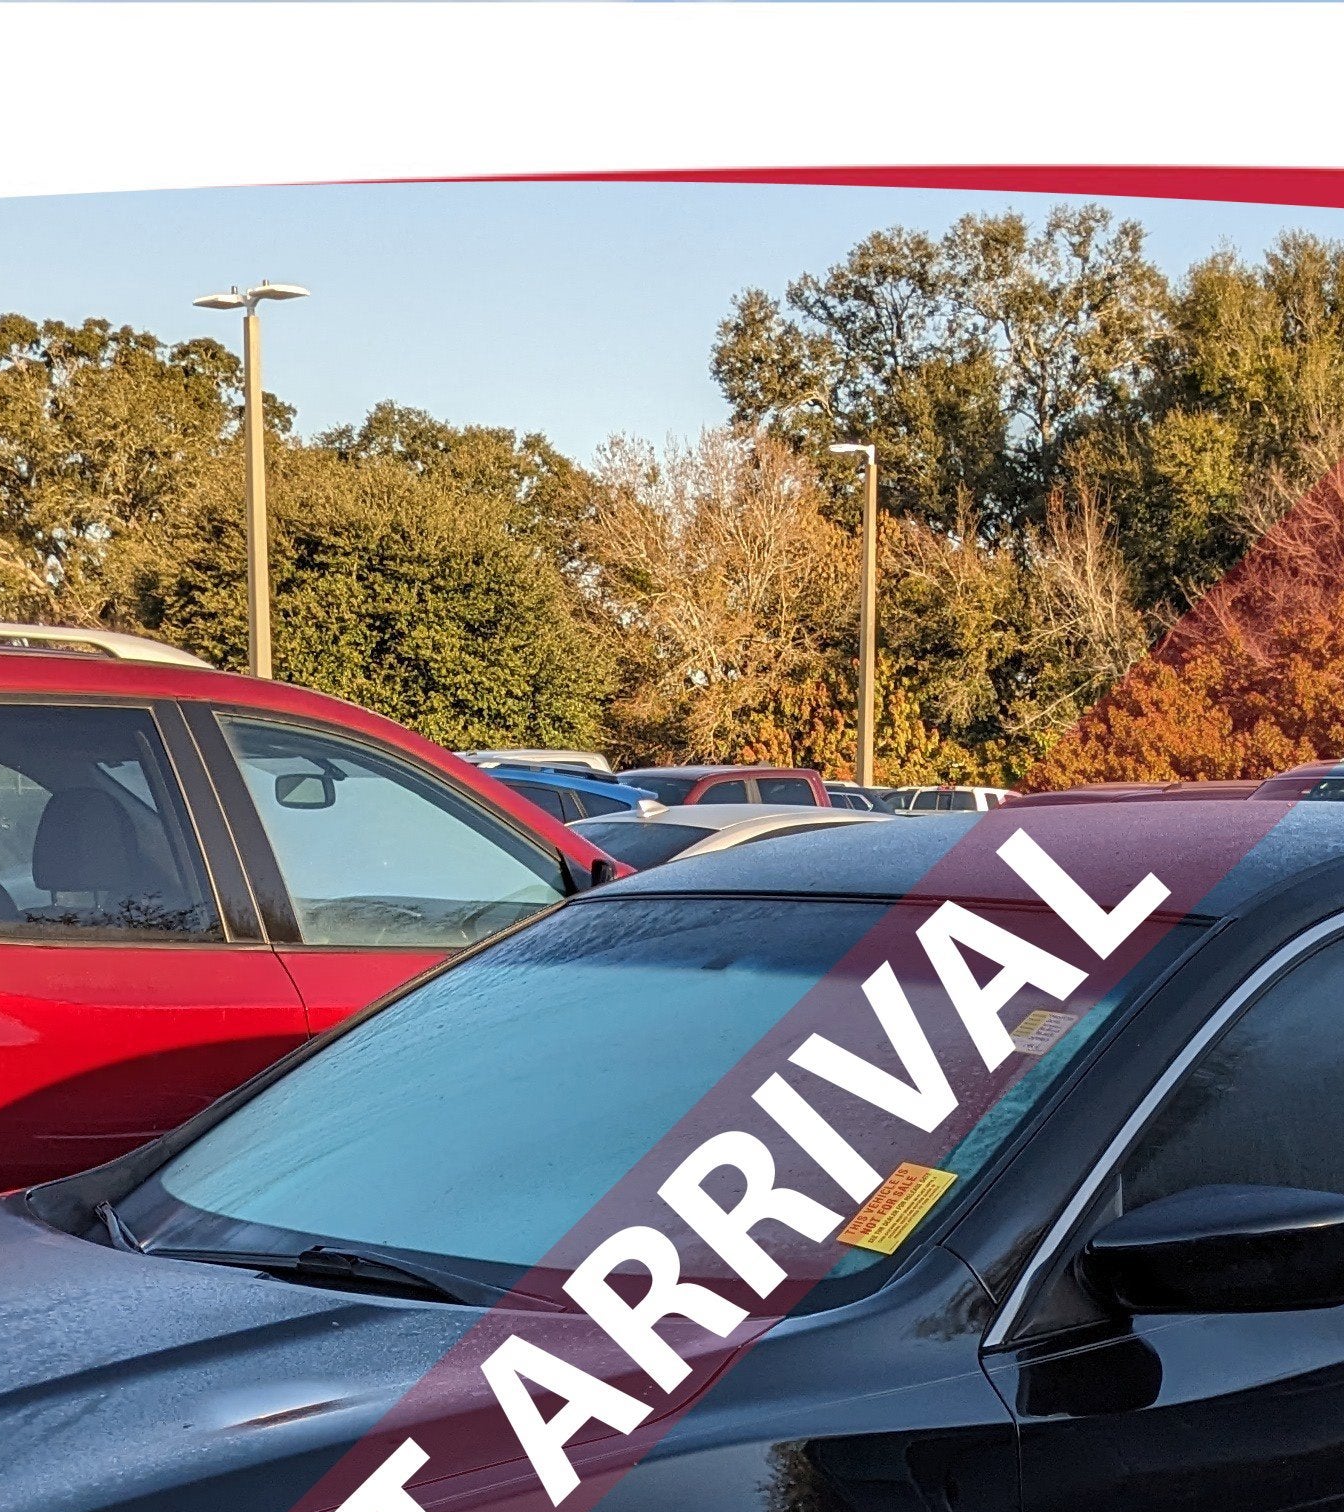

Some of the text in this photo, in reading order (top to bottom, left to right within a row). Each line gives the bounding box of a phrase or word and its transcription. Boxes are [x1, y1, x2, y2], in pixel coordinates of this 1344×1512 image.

[843, 1168, 909, 1236] THIS VEHICLE IS
[859, 1175, 918, 1236] NOT FOR SALE
